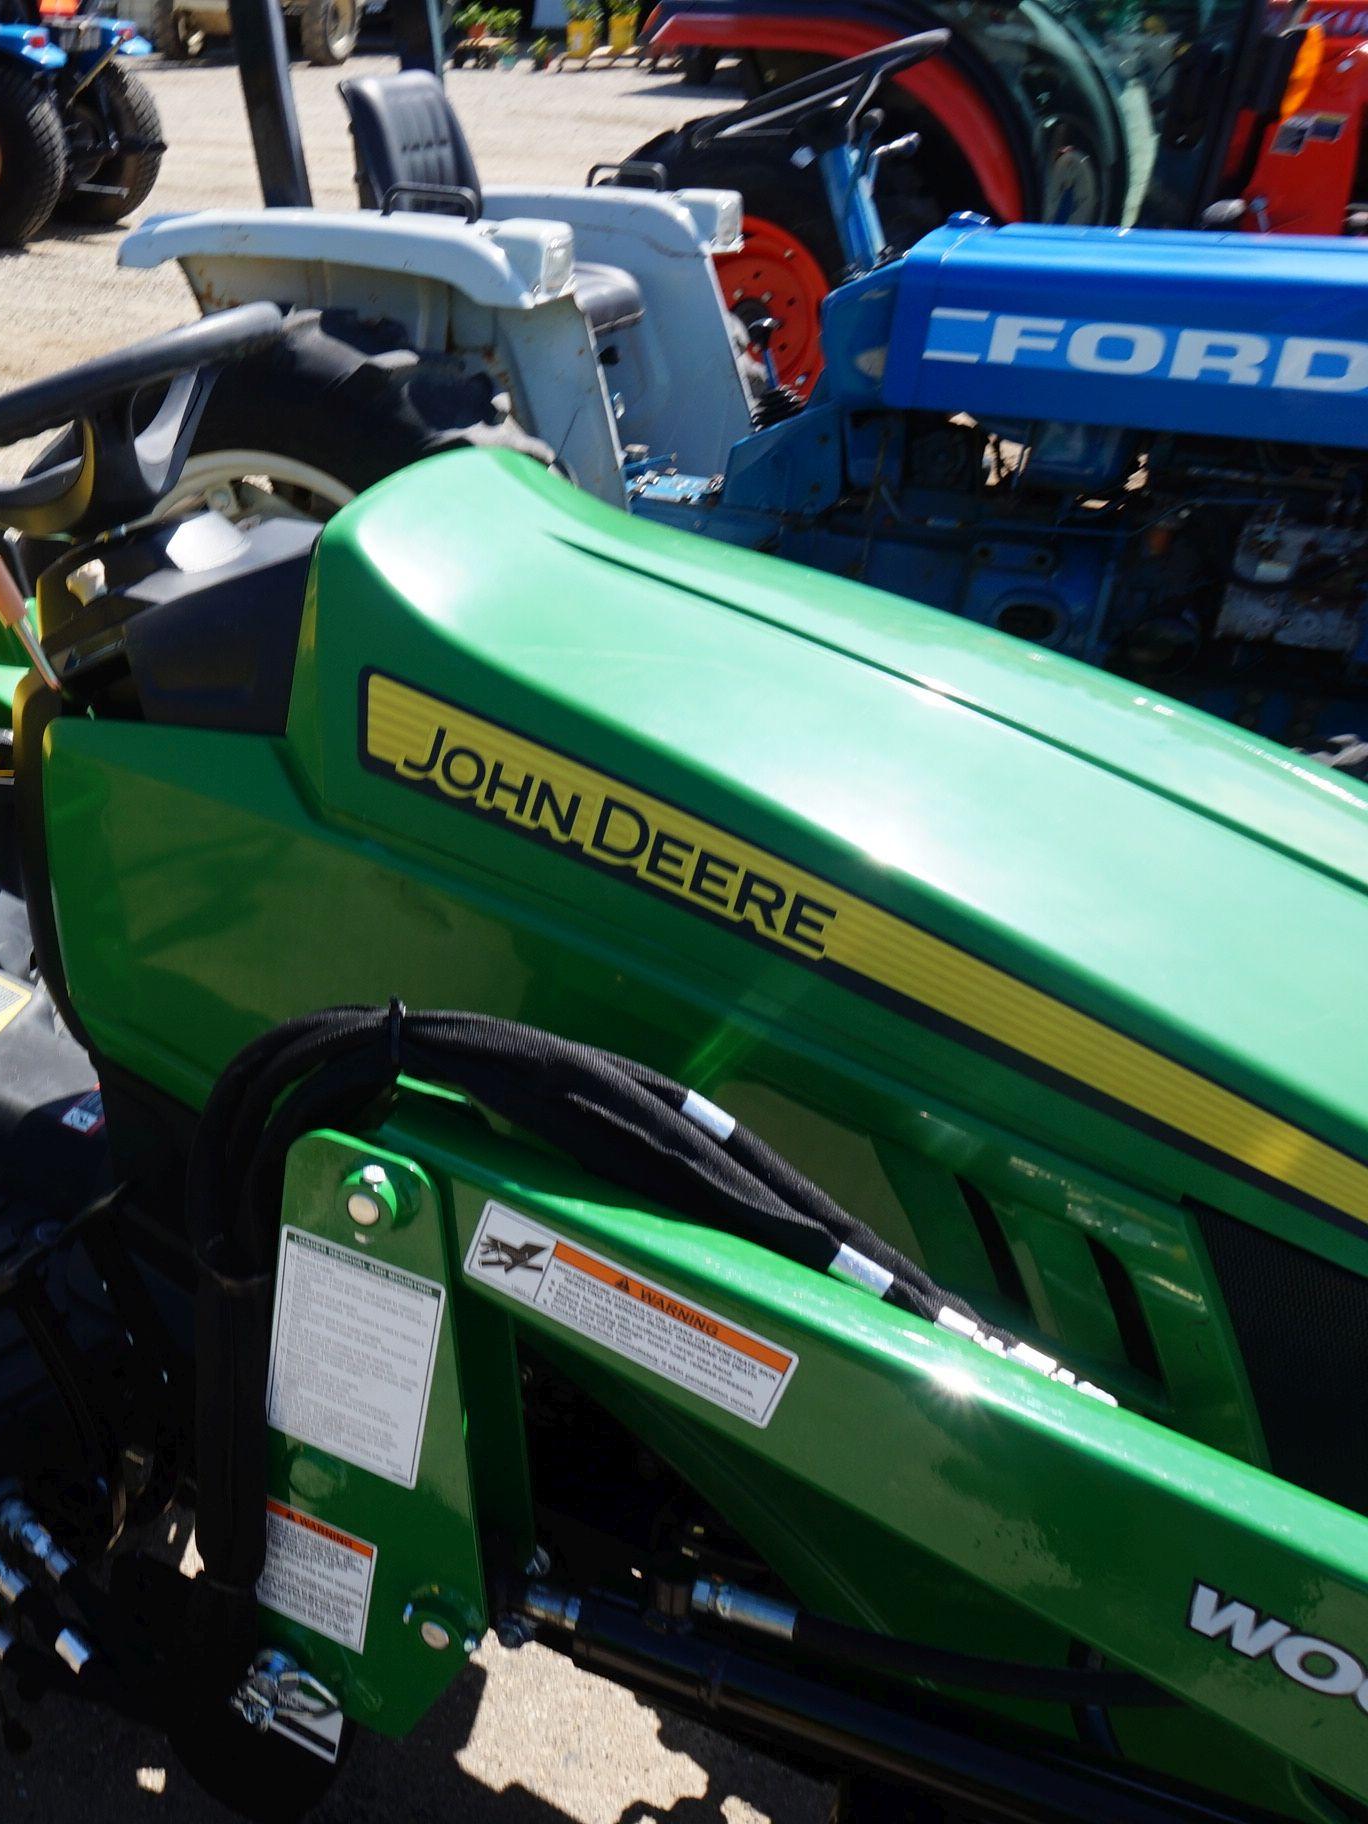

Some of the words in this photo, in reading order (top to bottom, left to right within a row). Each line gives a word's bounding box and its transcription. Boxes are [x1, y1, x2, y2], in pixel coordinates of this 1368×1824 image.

[987, 315, 1368, 393] FORD
[402, 727, 582, 837] JOHN
[593, 793, 838, 953] DEERE
[388, 1267, 433, 1295] MOUNTING
[640, 1287, 720, 1337] WARNING
[298, 1515, 353, 1548] WARNING
[1189, 1582, 1368, 1717] WO
